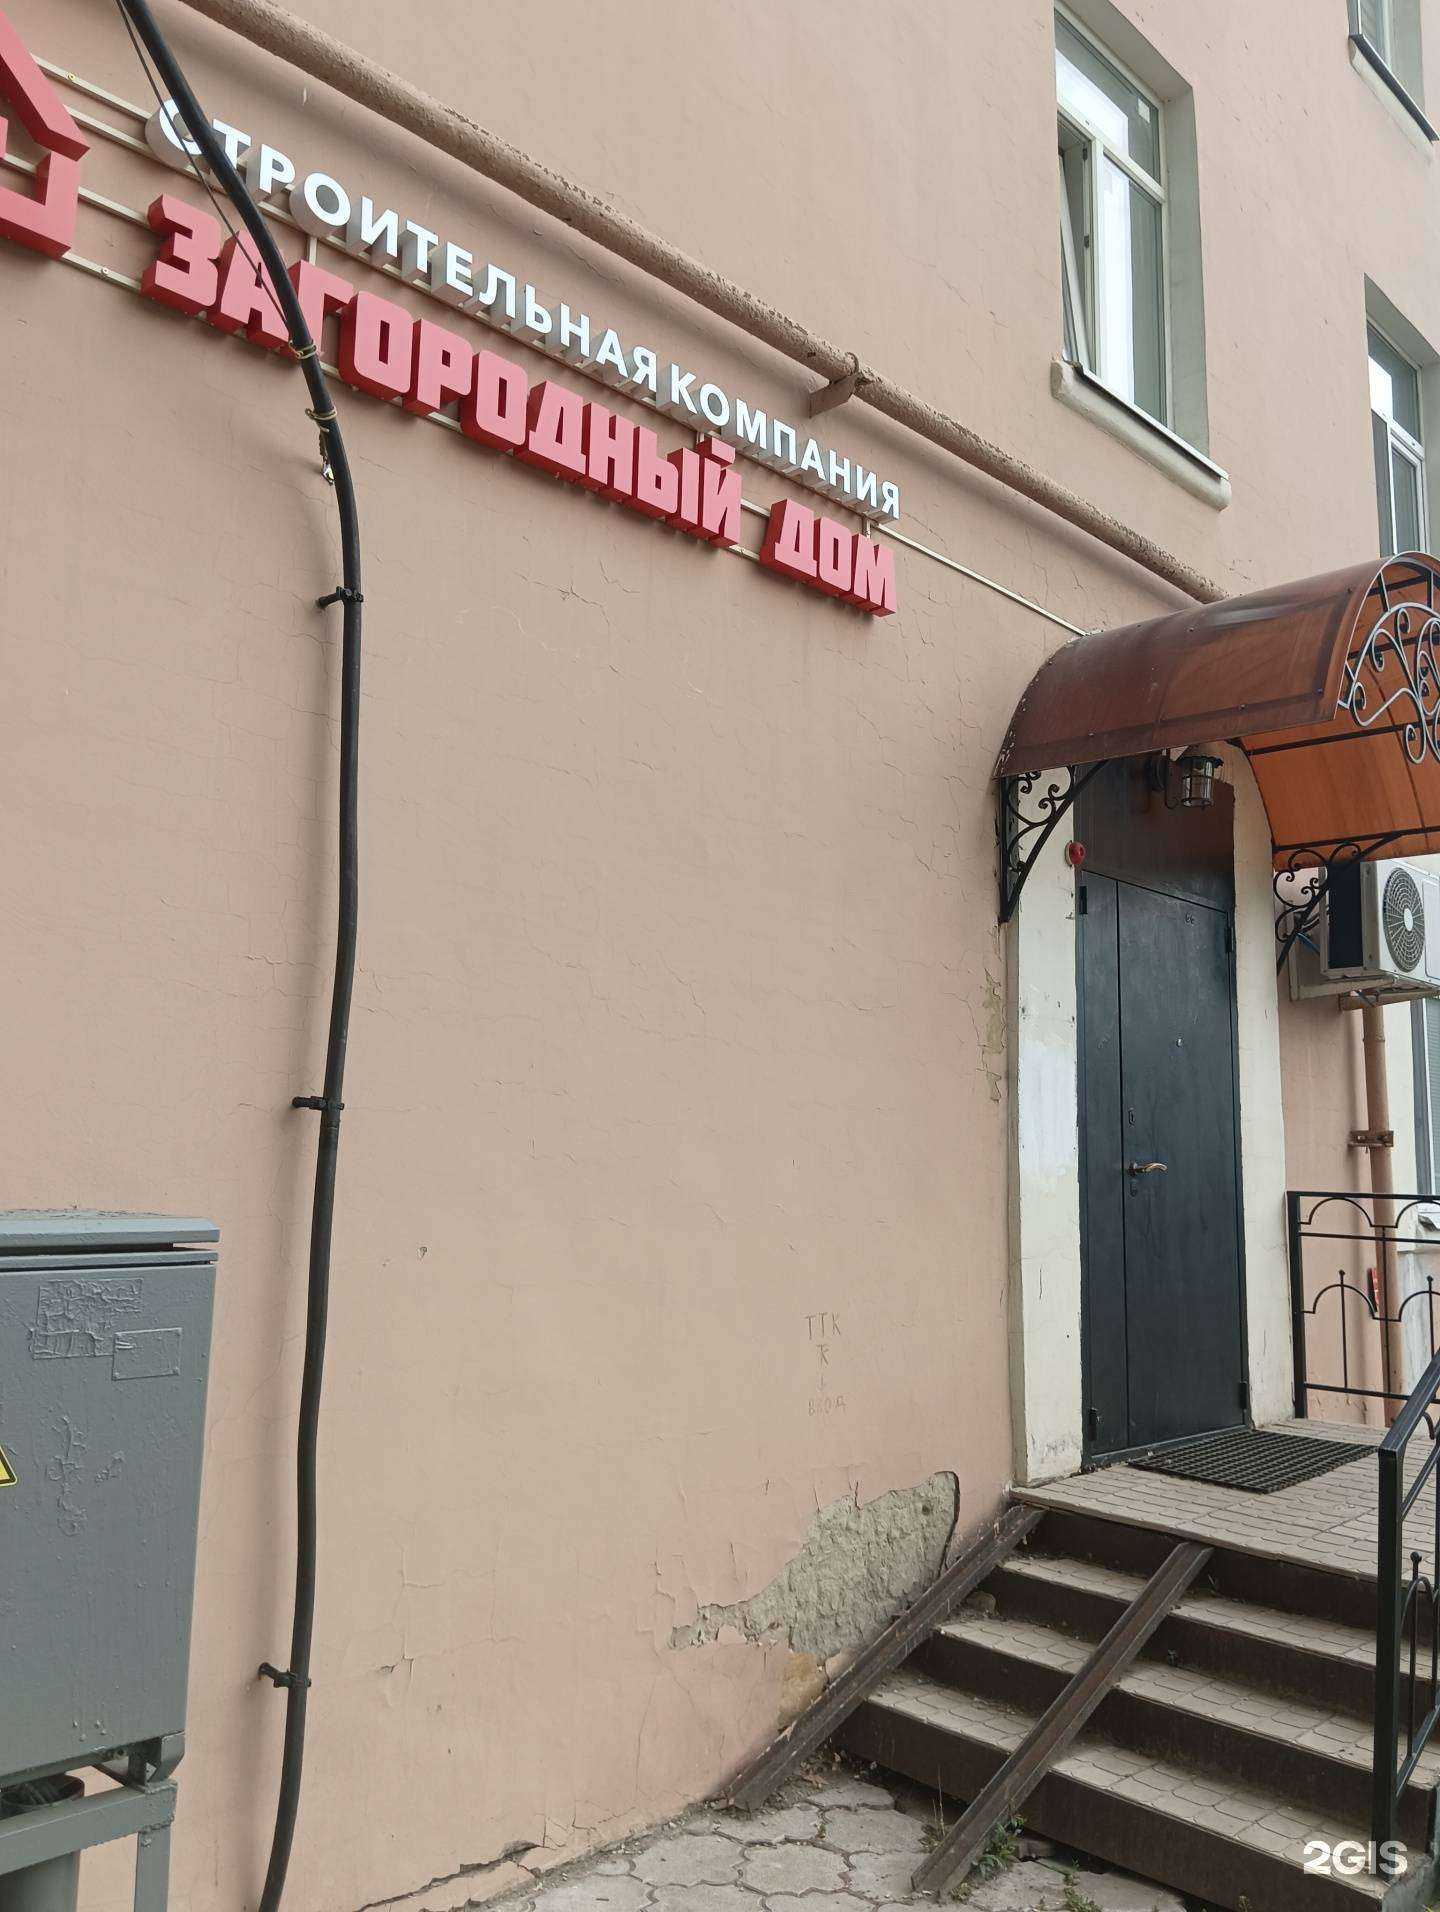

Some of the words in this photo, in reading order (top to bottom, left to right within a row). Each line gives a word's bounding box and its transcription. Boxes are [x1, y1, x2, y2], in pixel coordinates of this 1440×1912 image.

[150, 193, 742, 546] ЗАГОРОДНЫЙ
[772, 498, 896, 616] ДОМ
[159, 98, 658, 392] СТРОИТЕЛЬНАЯ
[670, 361, 901, 520] КОМПАНИЯ
